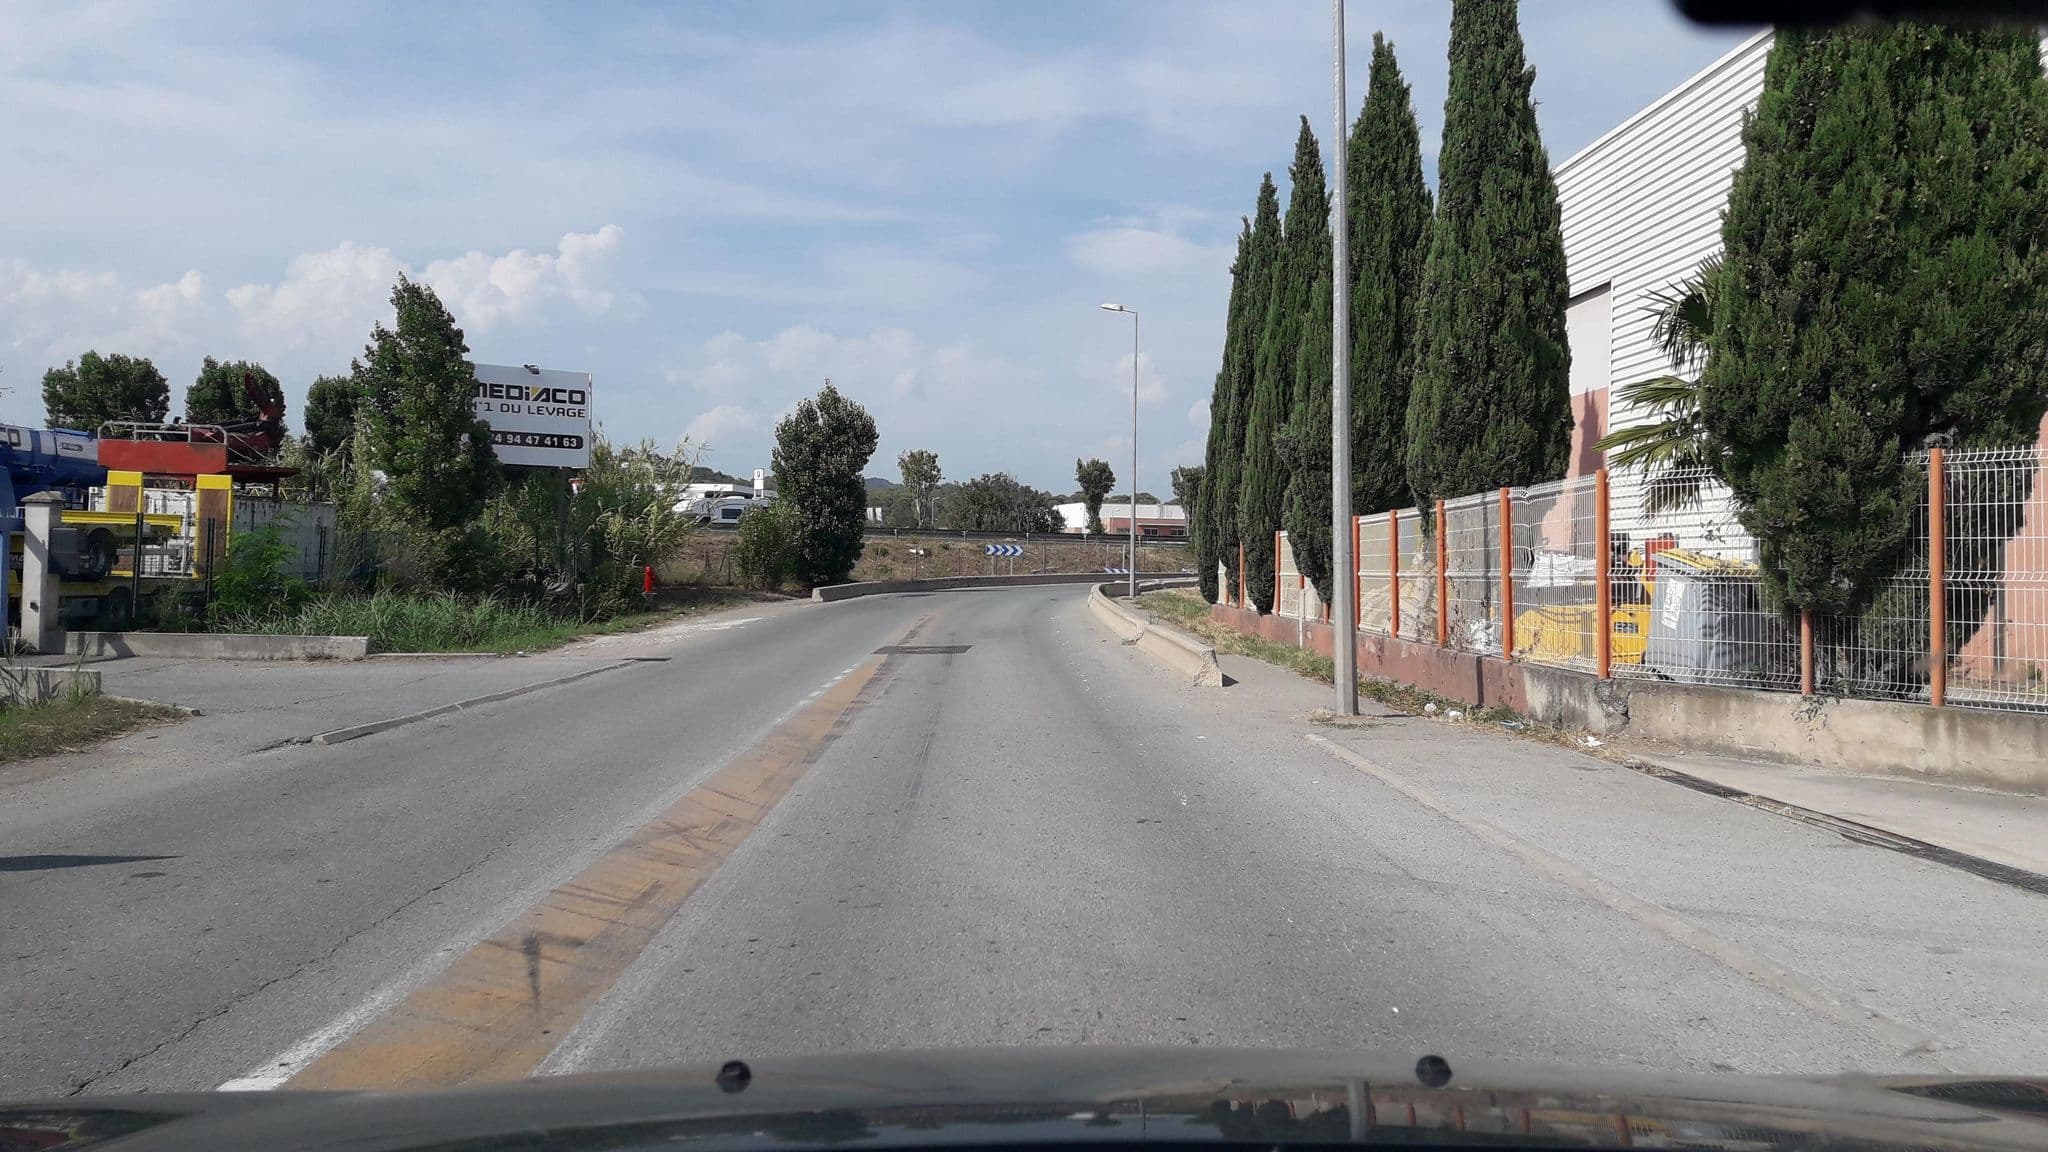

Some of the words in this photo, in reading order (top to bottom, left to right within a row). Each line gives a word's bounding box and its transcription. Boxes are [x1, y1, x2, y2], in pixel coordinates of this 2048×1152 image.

[500, 403, 521, 413] DU
[528, 405, 586, 418] LEVAGE
[506, 434, 521, 445] 94
[525, 435, 539, 446] 47
[544, 436, 558, 447] 41
[563, 437, 577, 447] 63
